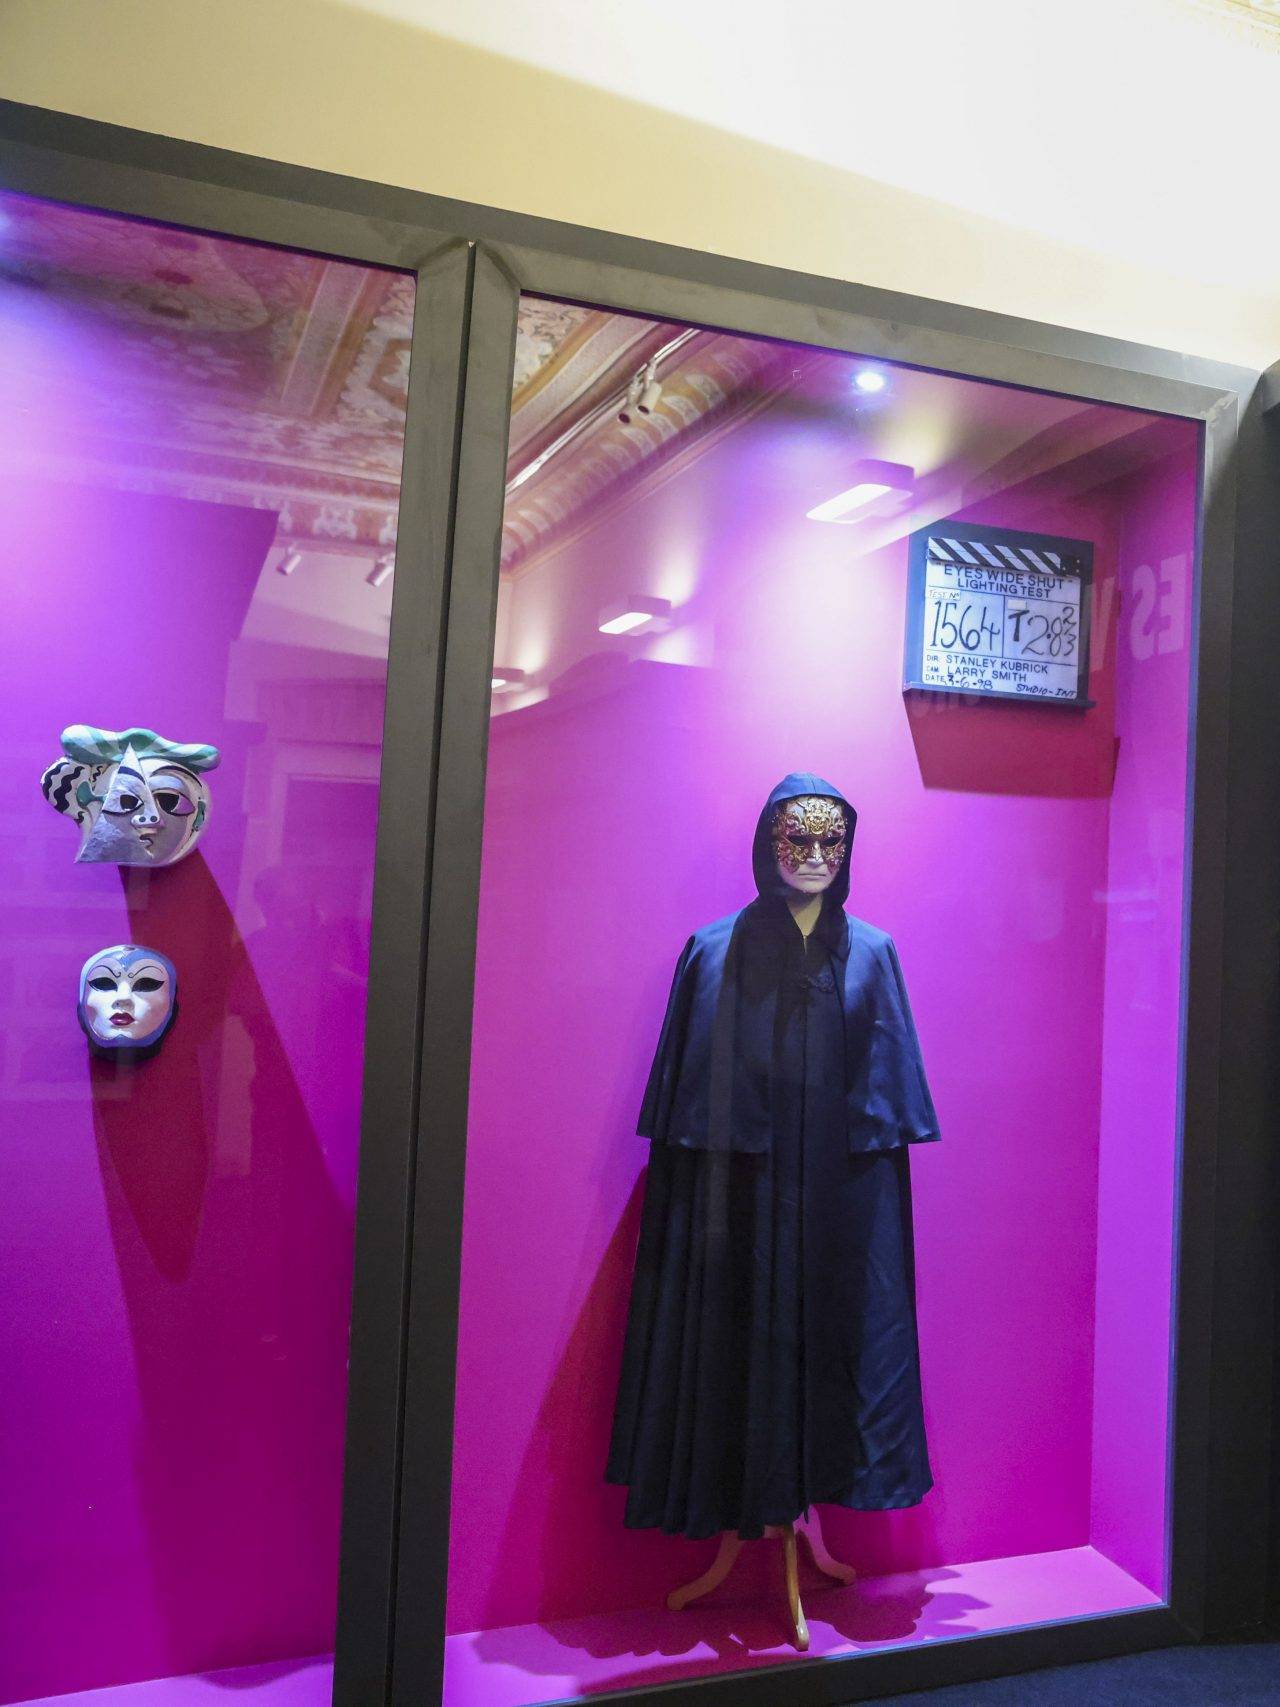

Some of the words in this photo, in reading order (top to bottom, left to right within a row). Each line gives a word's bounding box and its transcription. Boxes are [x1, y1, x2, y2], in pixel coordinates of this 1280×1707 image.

[987, 569, 1024, 585] WIDE
[957, 578, 1018, 594] LIGHTING
[1020, 586, 1051, 599] TEST
[929, 600, 1001, 651] 1564
[946, 654, 997, 668] STANLEY
[1001, 659, 1049, 675] KUBRICK
[925, 674, 945, 682] DATE
[947, 666, 986, 678] LARRY
[992, 670, 1027, 682] SMITH
